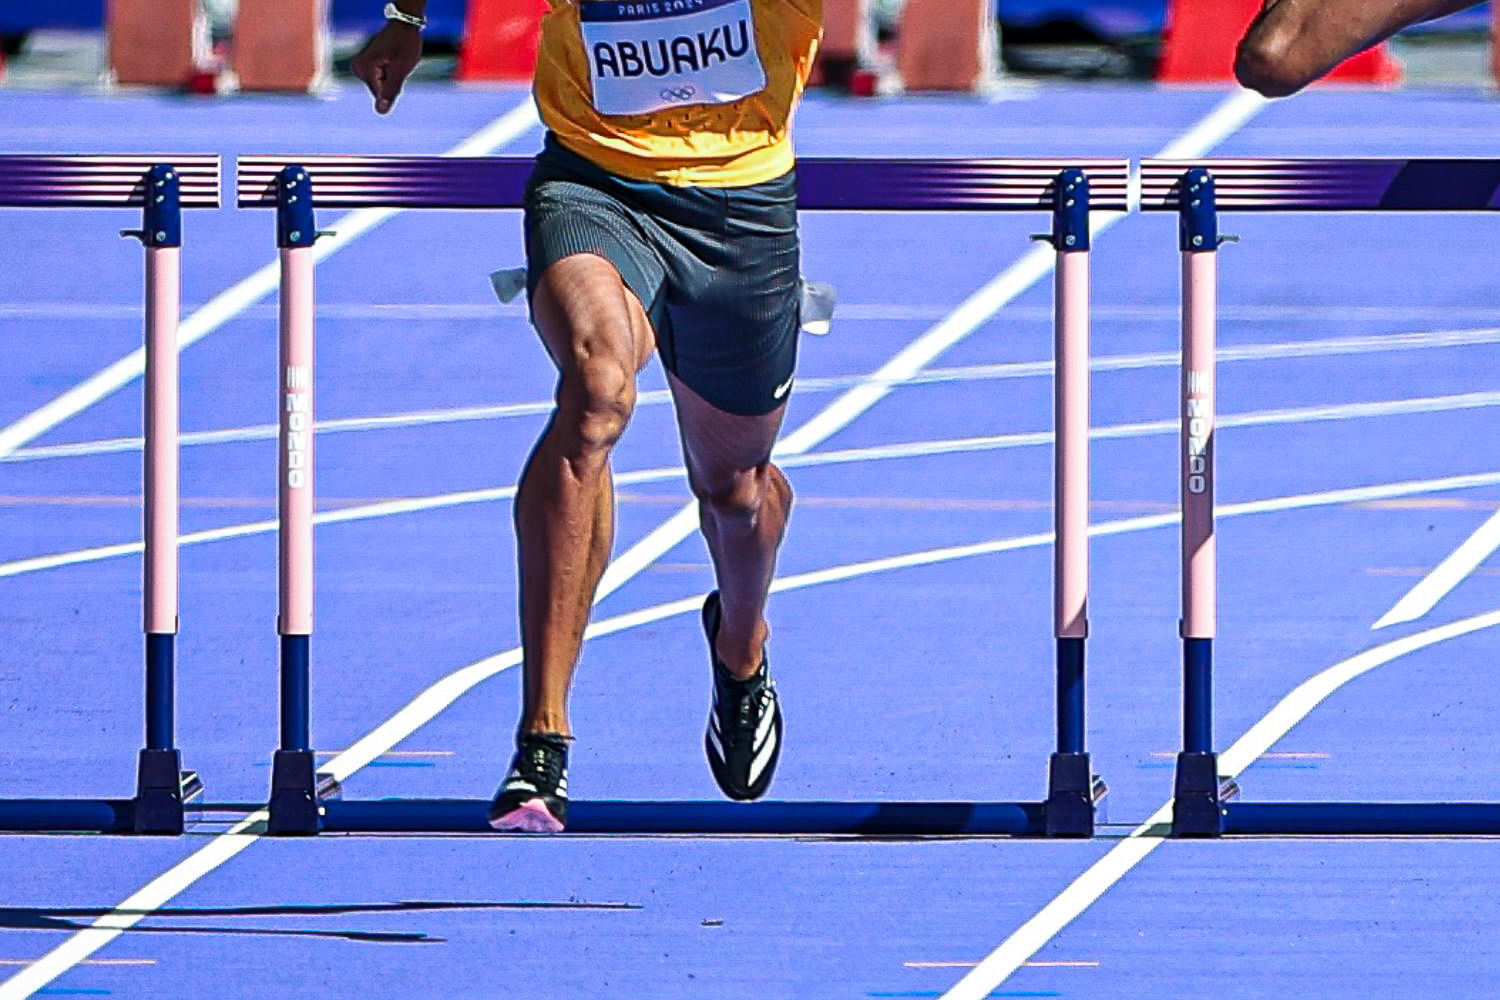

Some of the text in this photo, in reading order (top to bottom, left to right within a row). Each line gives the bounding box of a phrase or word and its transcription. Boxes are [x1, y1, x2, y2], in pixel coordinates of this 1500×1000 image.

[593, 20, 749, 78] ABUAKU
[286, 393, 308, 489] MONDO
[1187, 399, 1209, 494] MONDO
